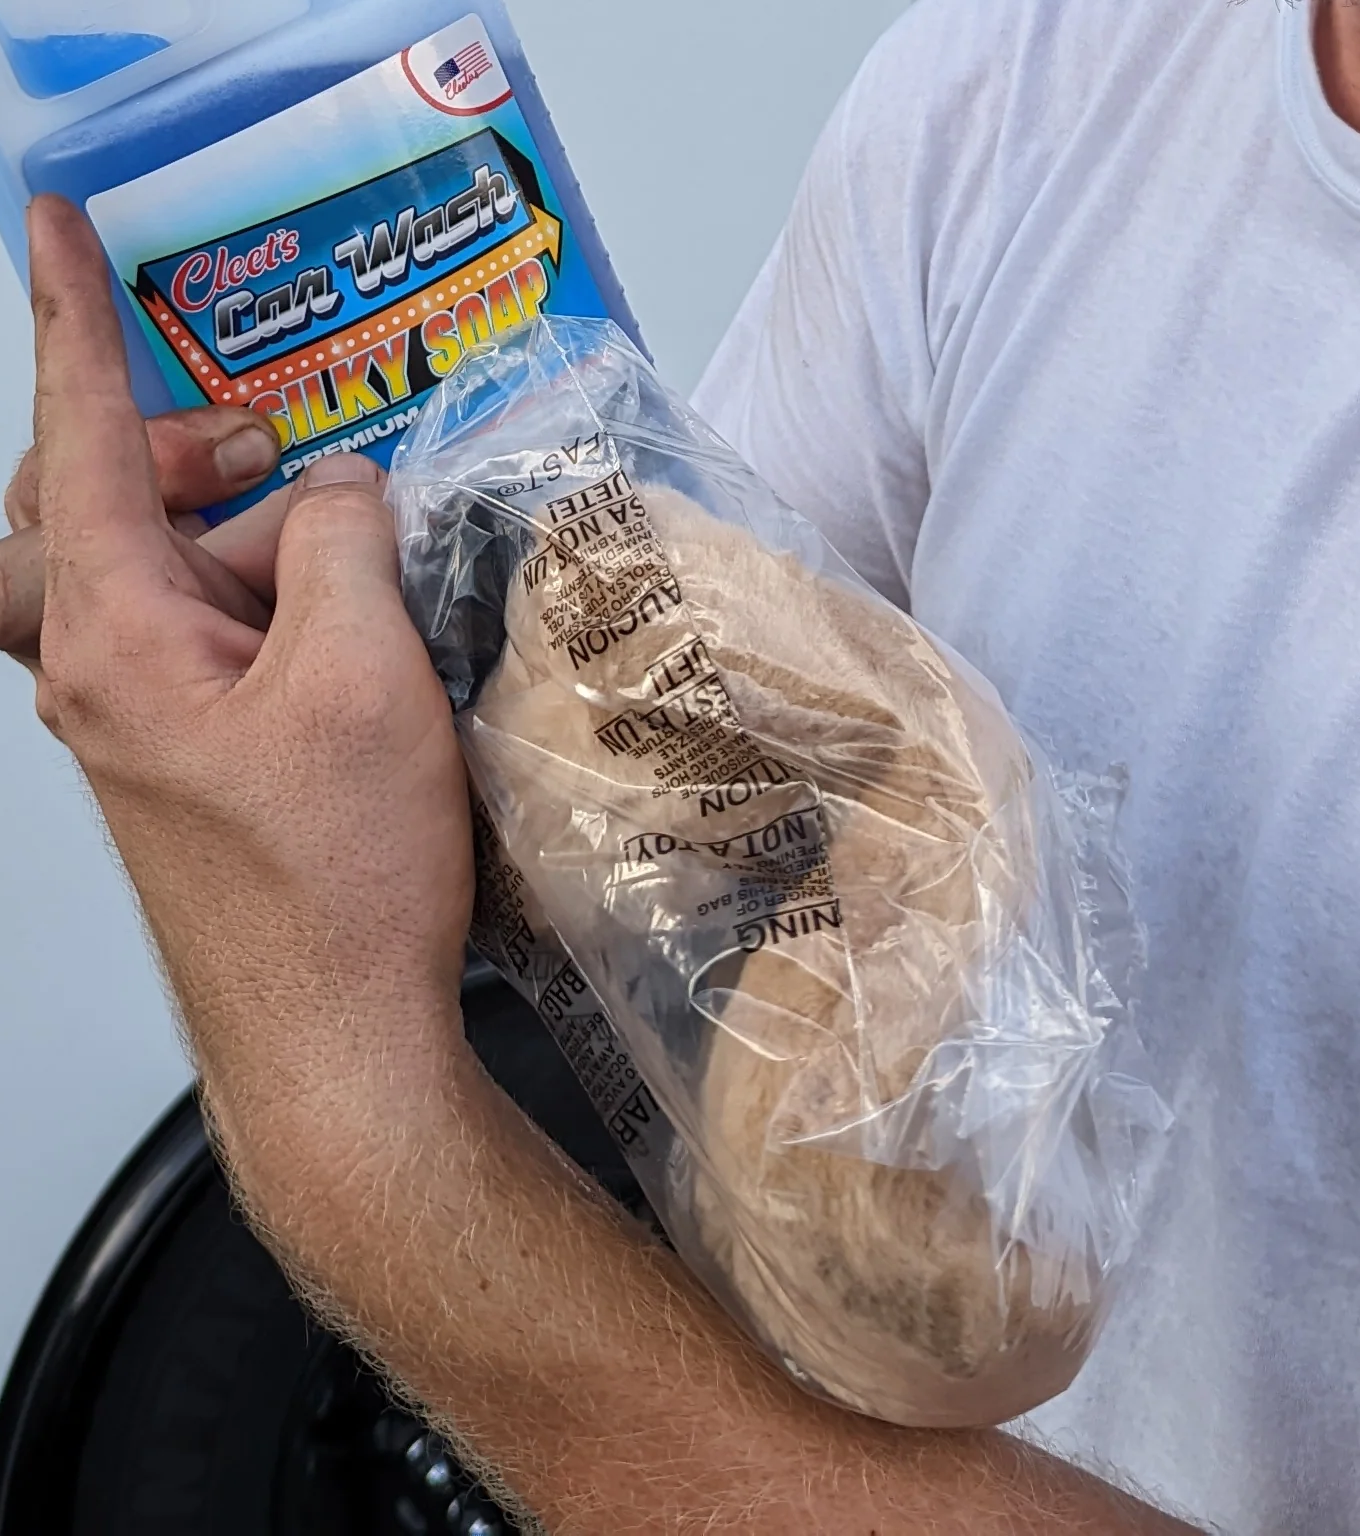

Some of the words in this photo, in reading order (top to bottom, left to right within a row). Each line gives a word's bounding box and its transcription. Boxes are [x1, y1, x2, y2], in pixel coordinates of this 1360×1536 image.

[170, 228, 300, 313] Cleet's
[247, 331, 411, 452] SILKY
[421, 259, 547, 378] SOAP
[743, 815, 806, 858] NOT
[696, 894, 731, 915] BAG
